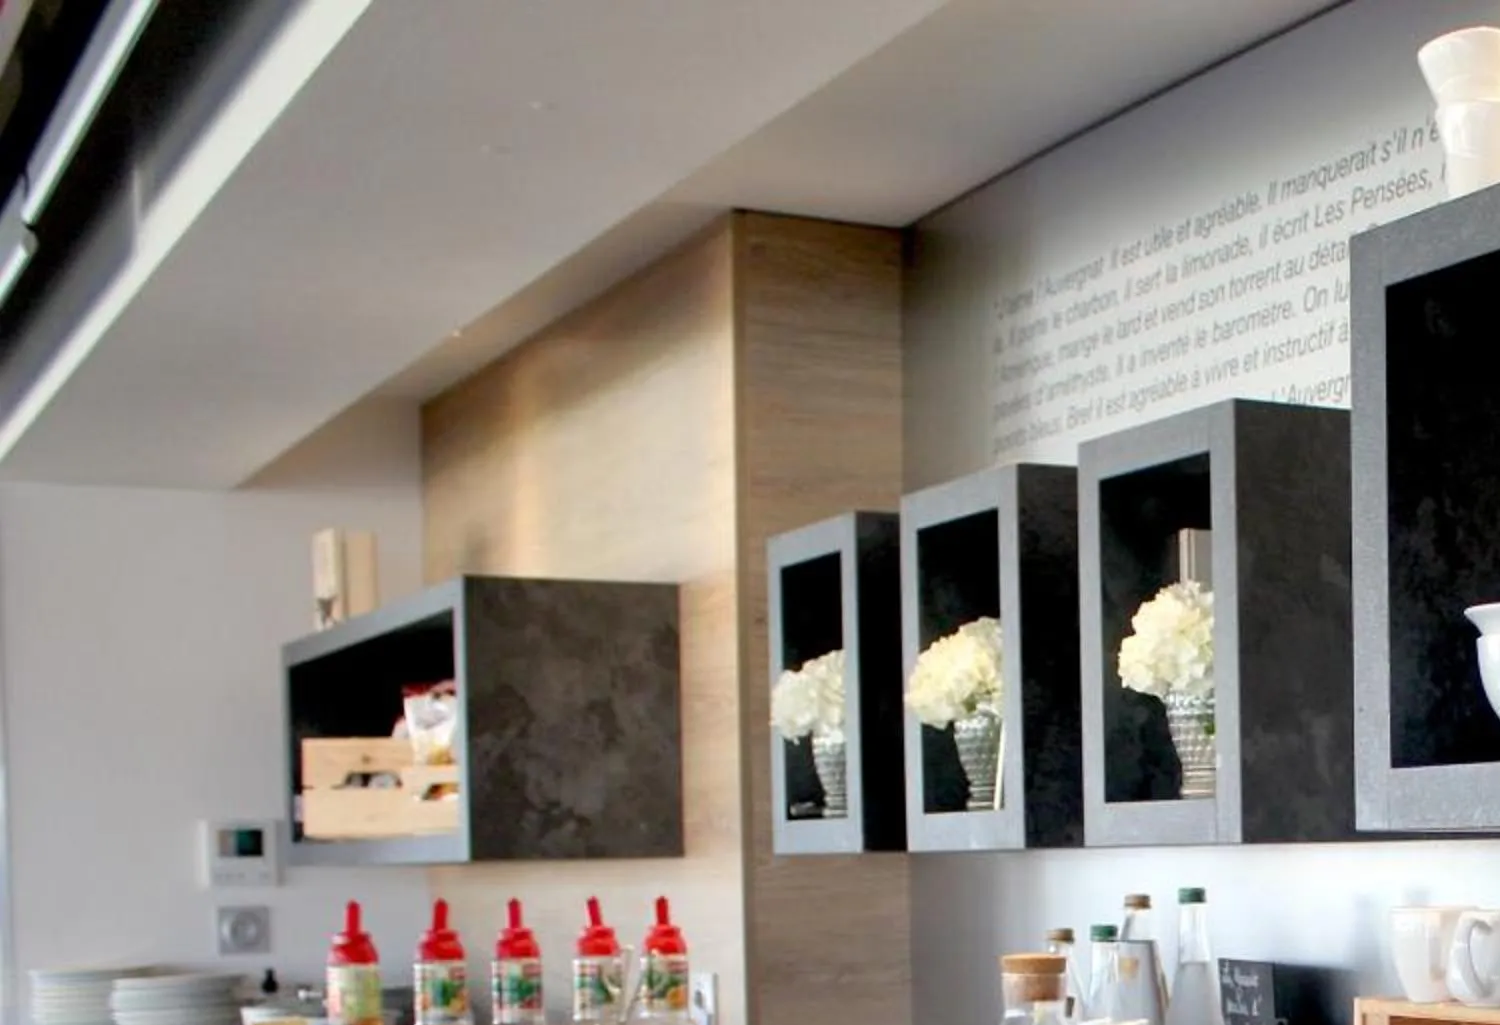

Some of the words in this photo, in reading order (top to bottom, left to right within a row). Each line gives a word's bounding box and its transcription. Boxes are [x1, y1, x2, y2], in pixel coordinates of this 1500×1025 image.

[1121, 239, 1143, 266] est
[1177, 217, 1191, 243] et
[1280, 143, 1378, 201] manquerait
[1380, 126, 1408, 162] s'il
[1411, 114, 1441, 150] n'é
[1181, 233, 1253, 278] limonade,
[1272, 208, 1310, 245] écrit
[1313, 200, 1345, 228] Les
[1350, 167, 1433, 215] Pensées,
[1144, 304, 1159, 331] et
[1161, 293, 1195, 324] vend
[1198, 284, 1226, 312] son
[1229, 262, 1281, 302] torrent
[1283, 255, 1305, 280] au
[1194, 326, 1207, 348] le
[1212, 299, 1296, 344] baromètre.
[1303, 285, 1329, 313] On
[1333, 276, 1350, 304] lu
[1205, 356, 1239, 385] vivre
[1243, 346, 1259, 373] et
[1262, 320, 1335, 363] instructif
